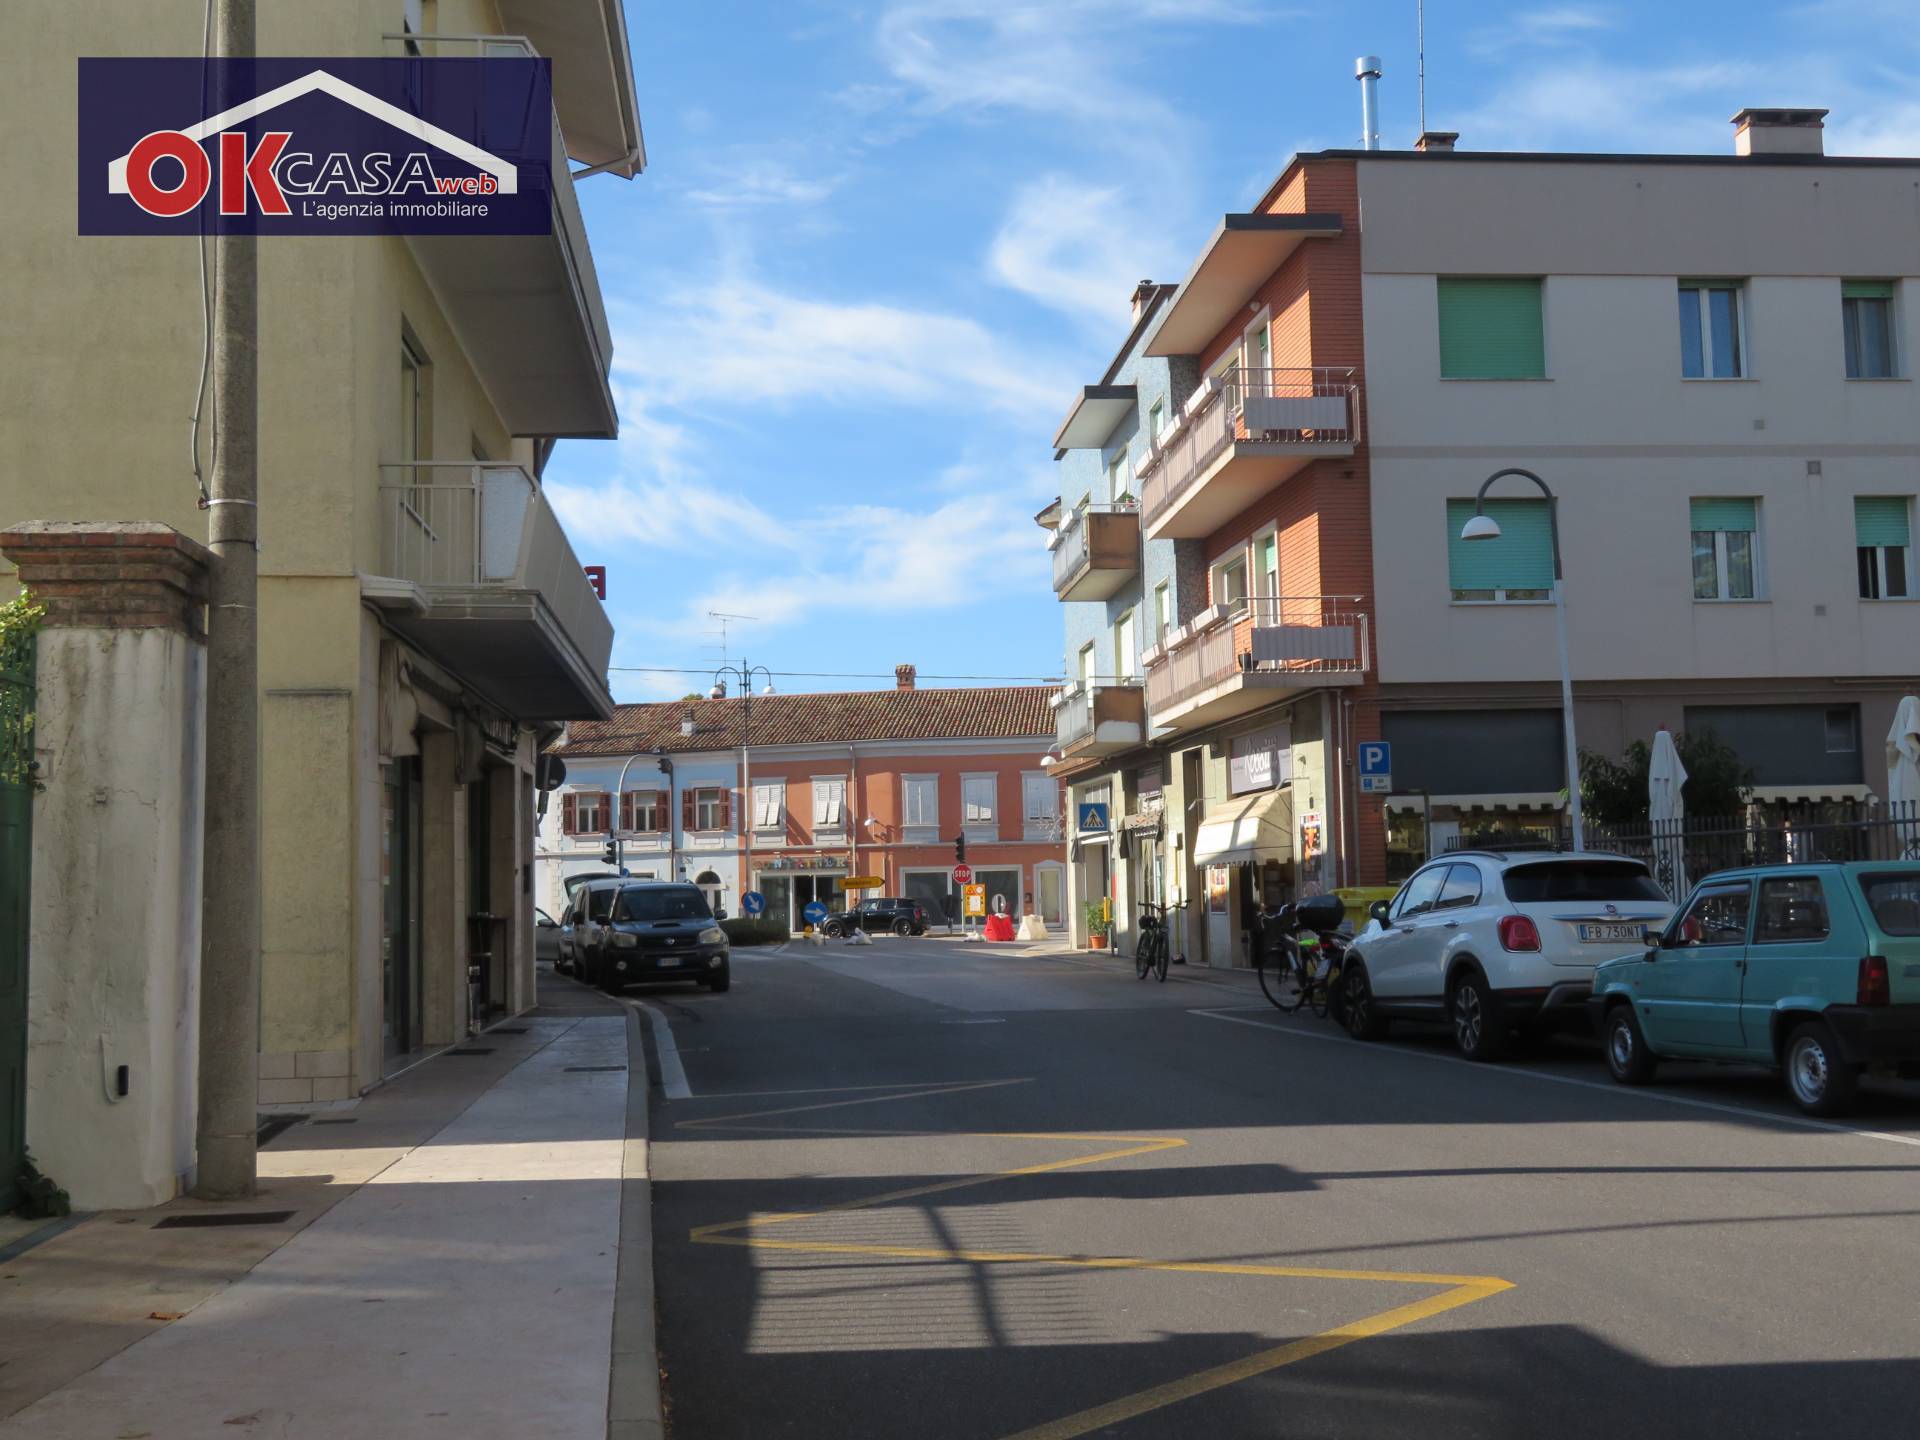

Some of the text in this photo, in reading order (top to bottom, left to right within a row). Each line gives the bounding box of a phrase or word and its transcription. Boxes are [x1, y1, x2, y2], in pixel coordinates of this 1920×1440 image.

[1366, 747, 1383, 770] P
[954, 870, 971, 878] STOP
[1588, 926, 1640, 938] FB 730NT
